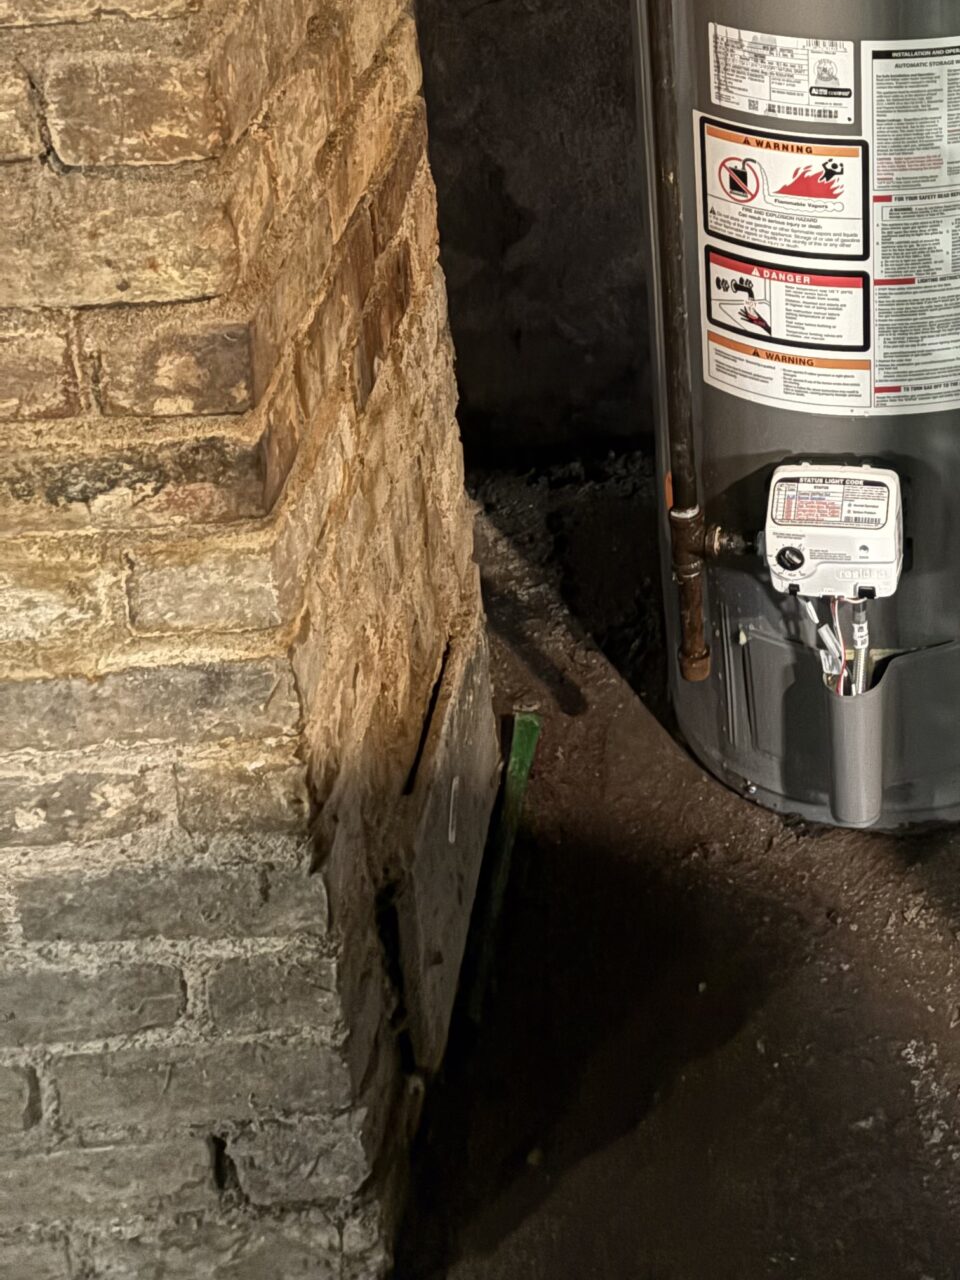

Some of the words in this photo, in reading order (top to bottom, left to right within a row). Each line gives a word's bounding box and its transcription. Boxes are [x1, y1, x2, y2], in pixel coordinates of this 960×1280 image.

[895, 61, 928, 69] AUTOMATIC
[756, 139, 813, 154] WARNING
[774, 199, 806, 207] Flammable
[763, 270, 811, 284] DANGER
[765, 352, 814, 367] WARNING
